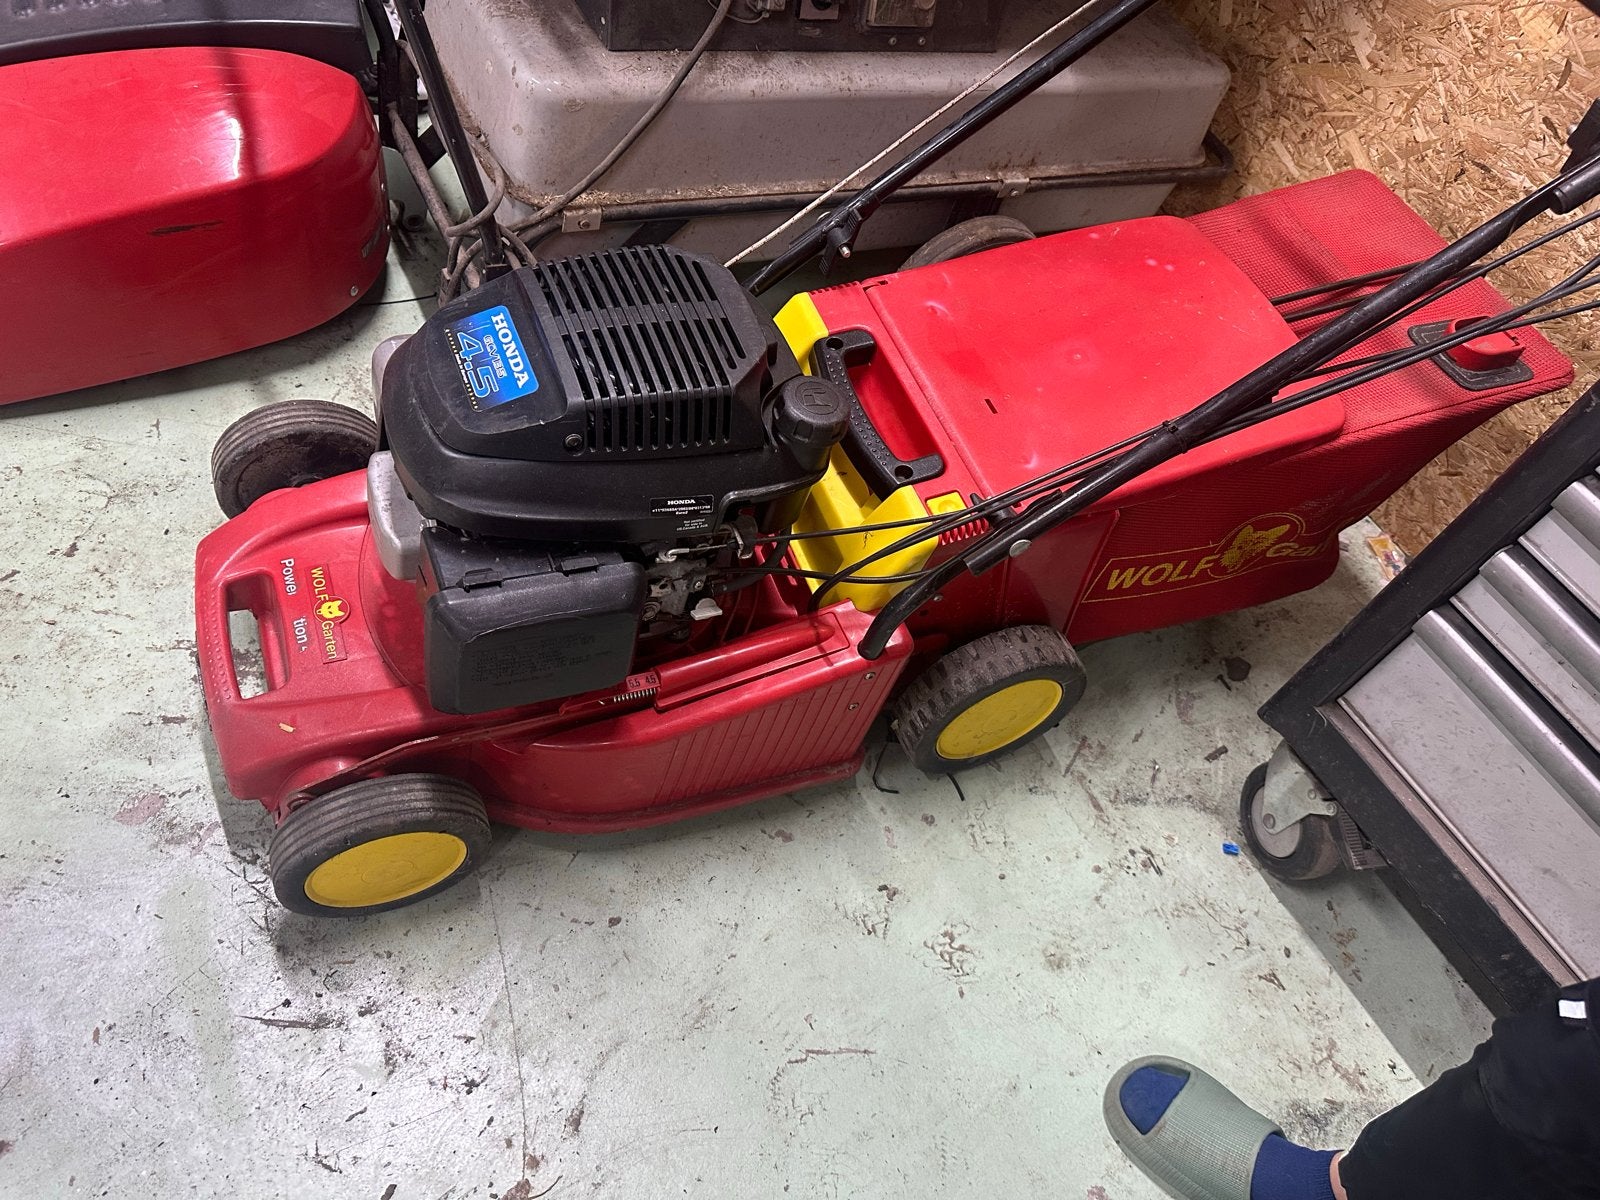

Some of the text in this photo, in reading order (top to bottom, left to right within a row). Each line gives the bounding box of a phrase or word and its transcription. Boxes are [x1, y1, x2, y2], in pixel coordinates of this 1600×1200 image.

[457, 331, 499, 398] 4.5
[491, 312, 529, 389] HONDA
[1107, 553, 1221, 591] WOLF
[311, 567, 337, 659] WOLF Garten
